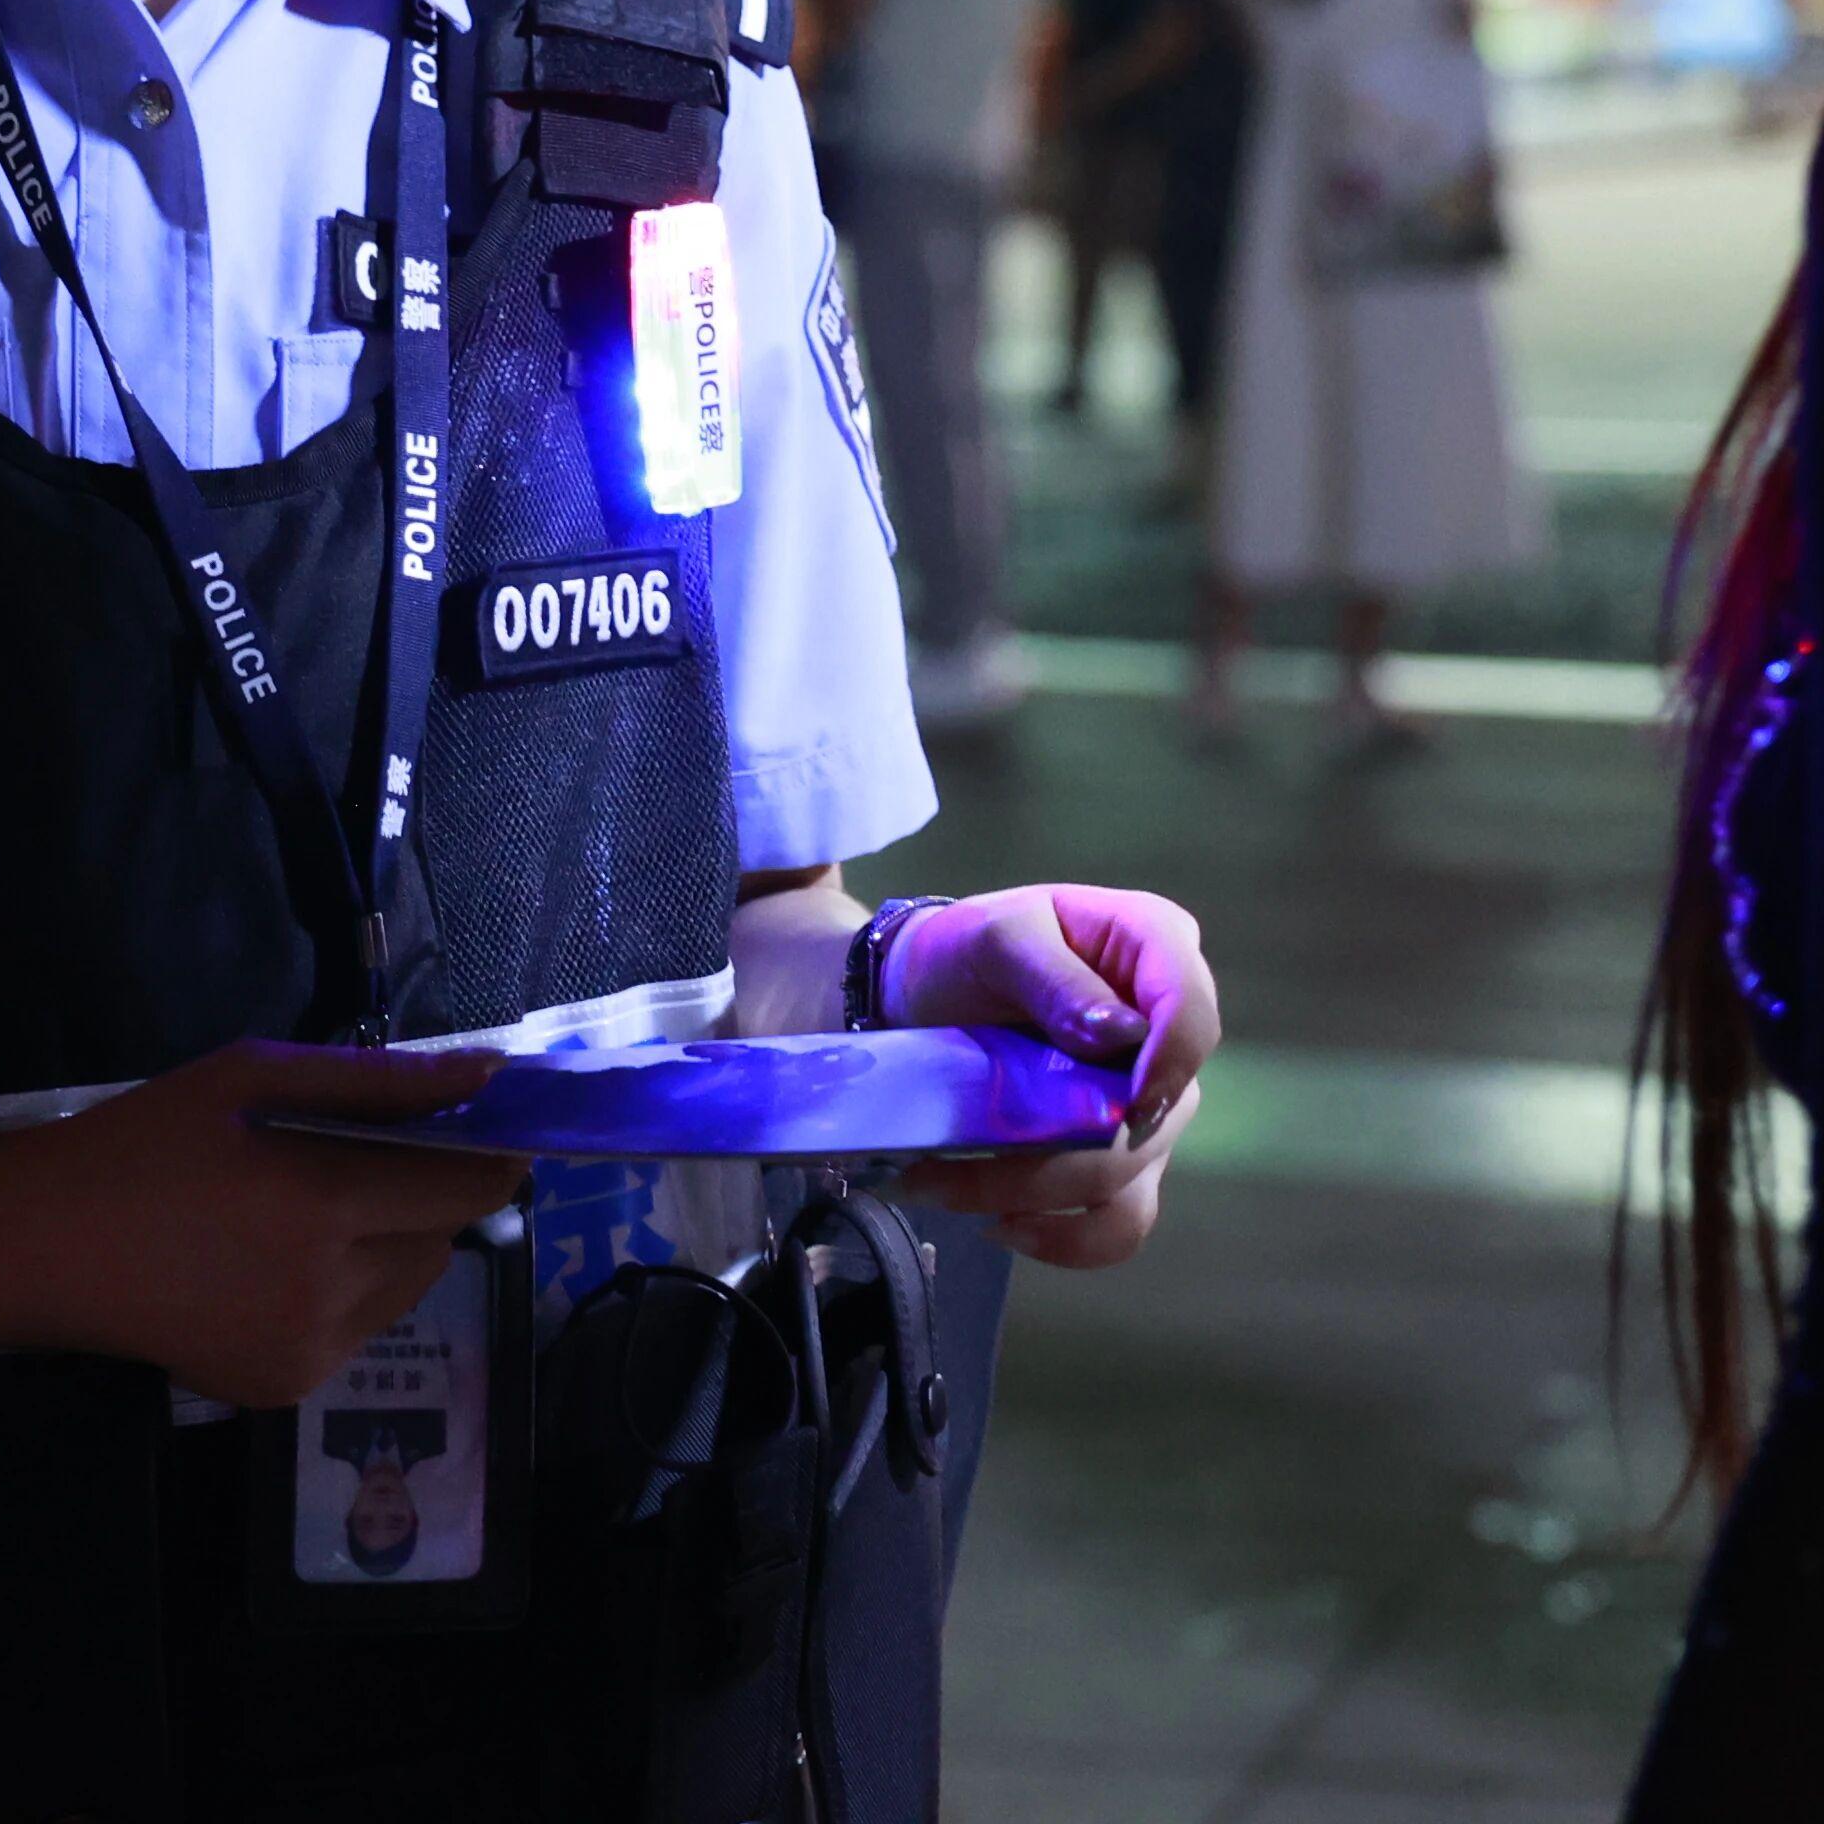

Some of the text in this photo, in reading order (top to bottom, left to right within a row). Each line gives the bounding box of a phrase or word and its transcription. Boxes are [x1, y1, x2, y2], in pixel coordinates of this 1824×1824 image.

[400, 255, 441, 333] 警察
[402, 432, 439, 582] POLICE
[190, 551, 278, 705] POLICE
[493, 569, 672, 654] 007406
[380, 754, 413, 840] 警察
